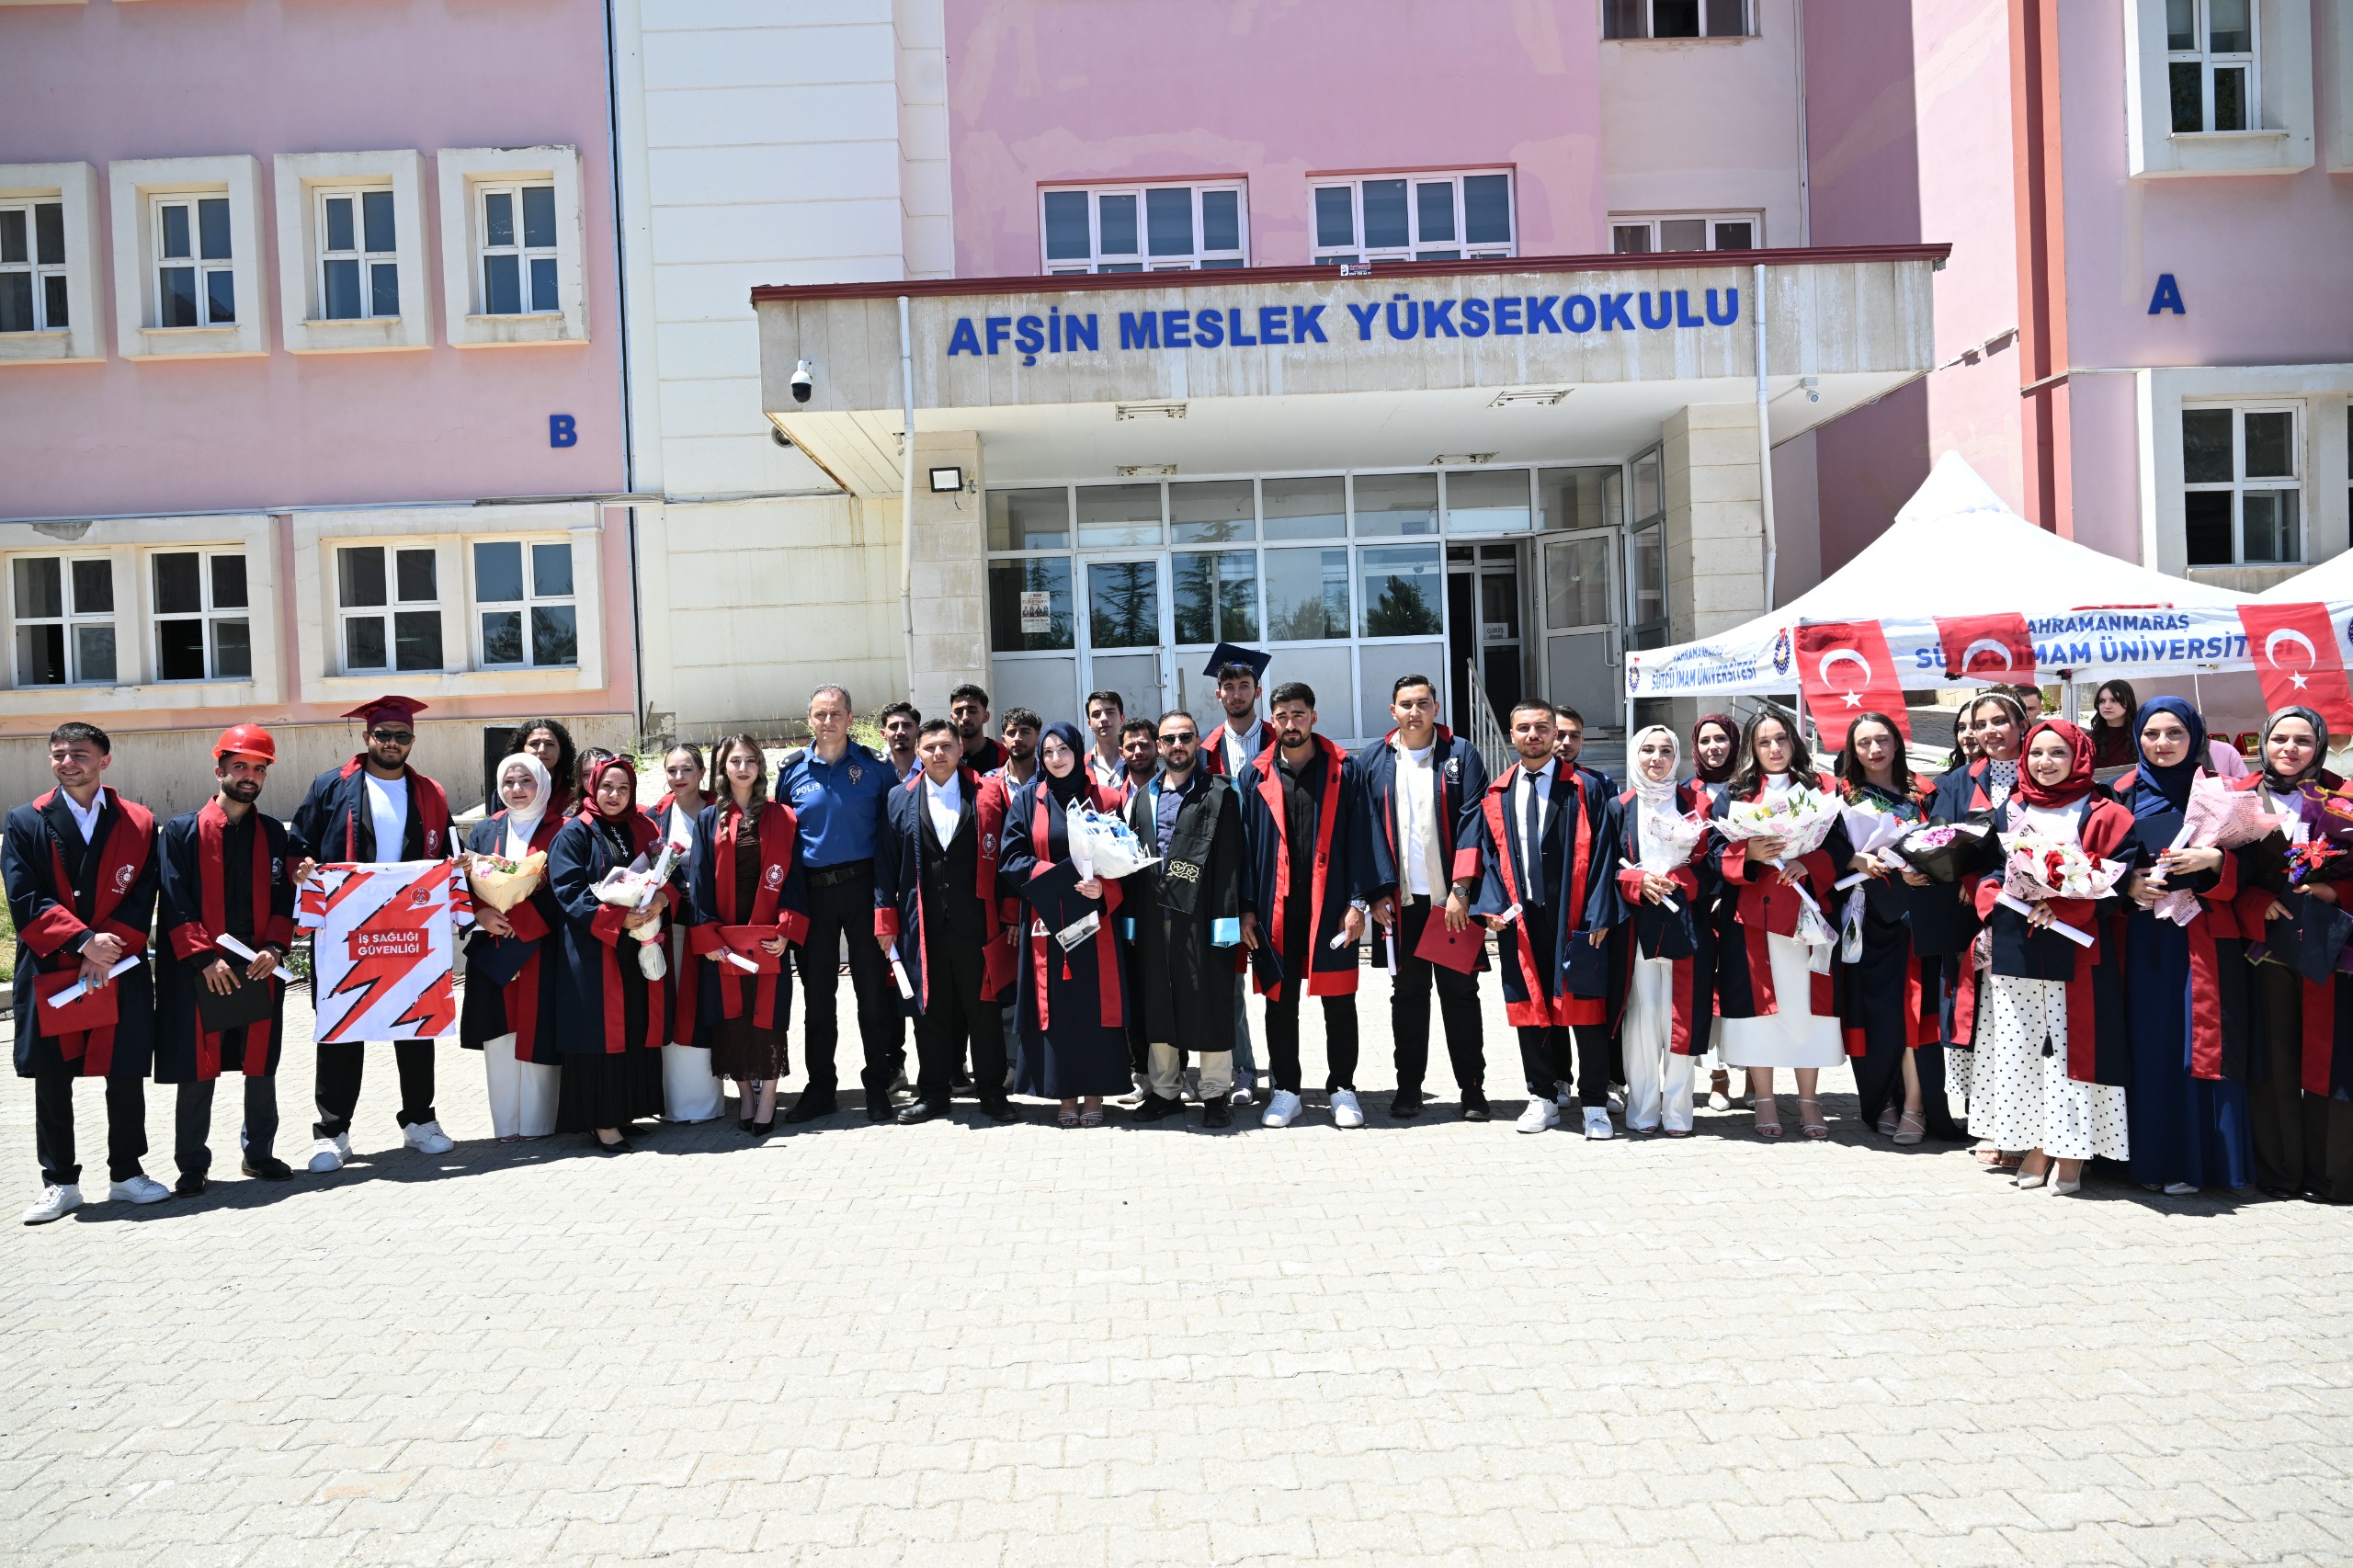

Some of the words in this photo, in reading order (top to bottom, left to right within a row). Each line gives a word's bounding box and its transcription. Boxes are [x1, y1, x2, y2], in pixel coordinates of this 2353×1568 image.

[2147, 274, 2187, 314] A
[948, 306, 1099, 367] AFŞİN
[1120, 305, 1329, 351] MESLEK
[1347, 289, 1740, 341] YÜKSEKOKULU
[549, 415, 578, 449] B
[1486, 626, 1505, 634] GİRİŞ
[1651, 667, 1675, 693] SÜTÇÜ
[1676, 666, 1696, 689] İMAM
[1697, 654, 1757, 687] ÜNİVERSİTESİ
[795, 782, 821, 796] POLİS
[358, 933, 369, 945] İŞ
[372, 931, 419, 943] SAĞLIĞI
[358, 943, 420, 956] GÜVENLİĞİ
